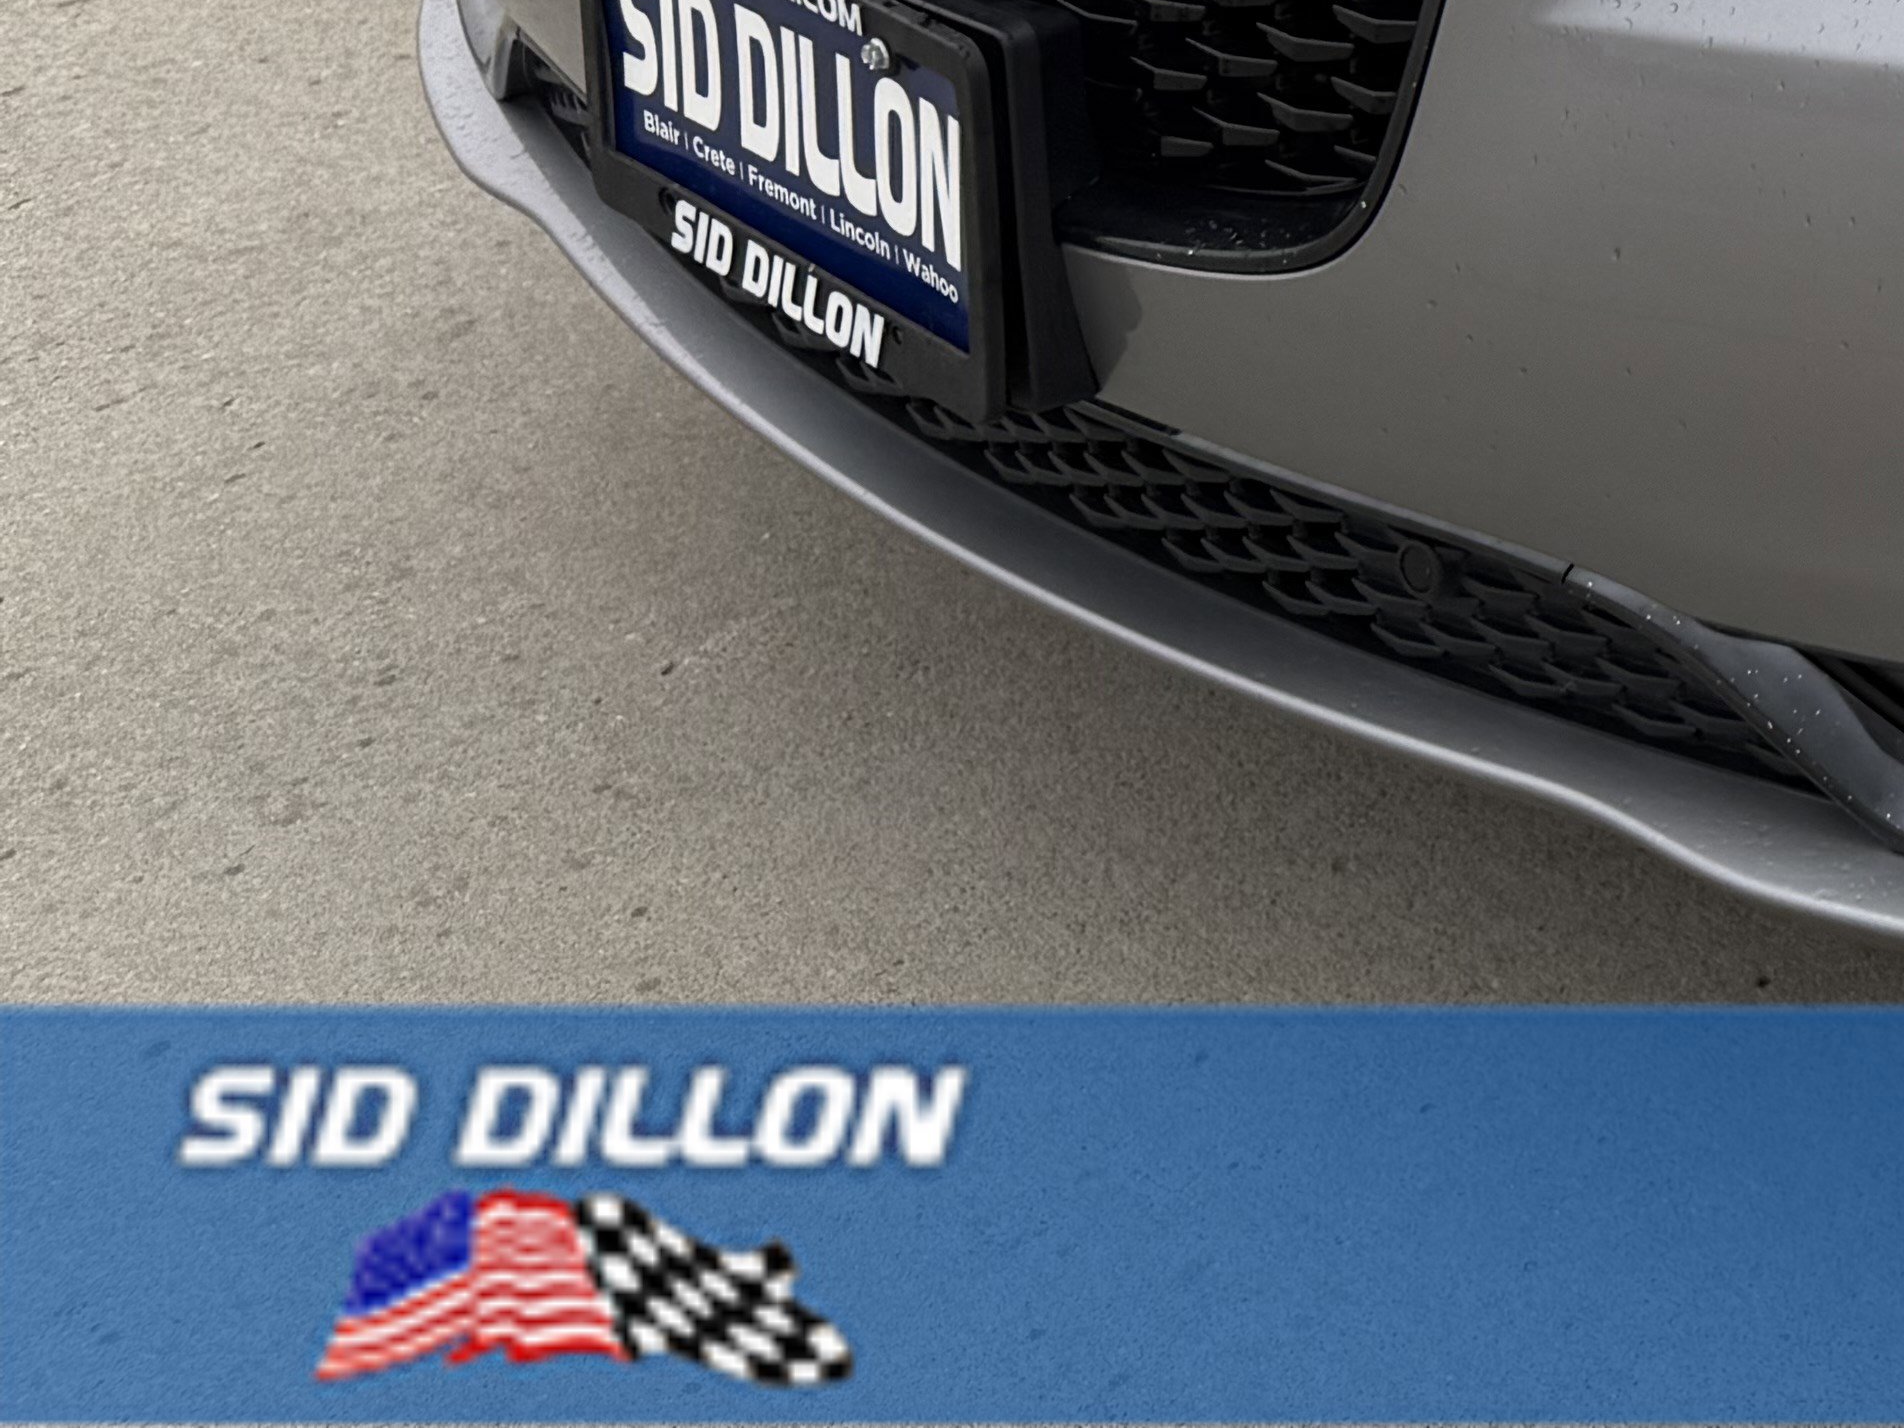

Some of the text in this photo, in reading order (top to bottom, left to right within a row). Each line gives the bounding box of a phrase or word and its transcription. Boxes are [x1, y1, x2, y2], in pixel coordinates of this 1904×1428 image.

[642, 108, 960, 305] Blair Crete Fremont Lincoln Wahoo
[732, 2, 963, 274] DILLON
[669, 198, 886, 369] SID DILLON
